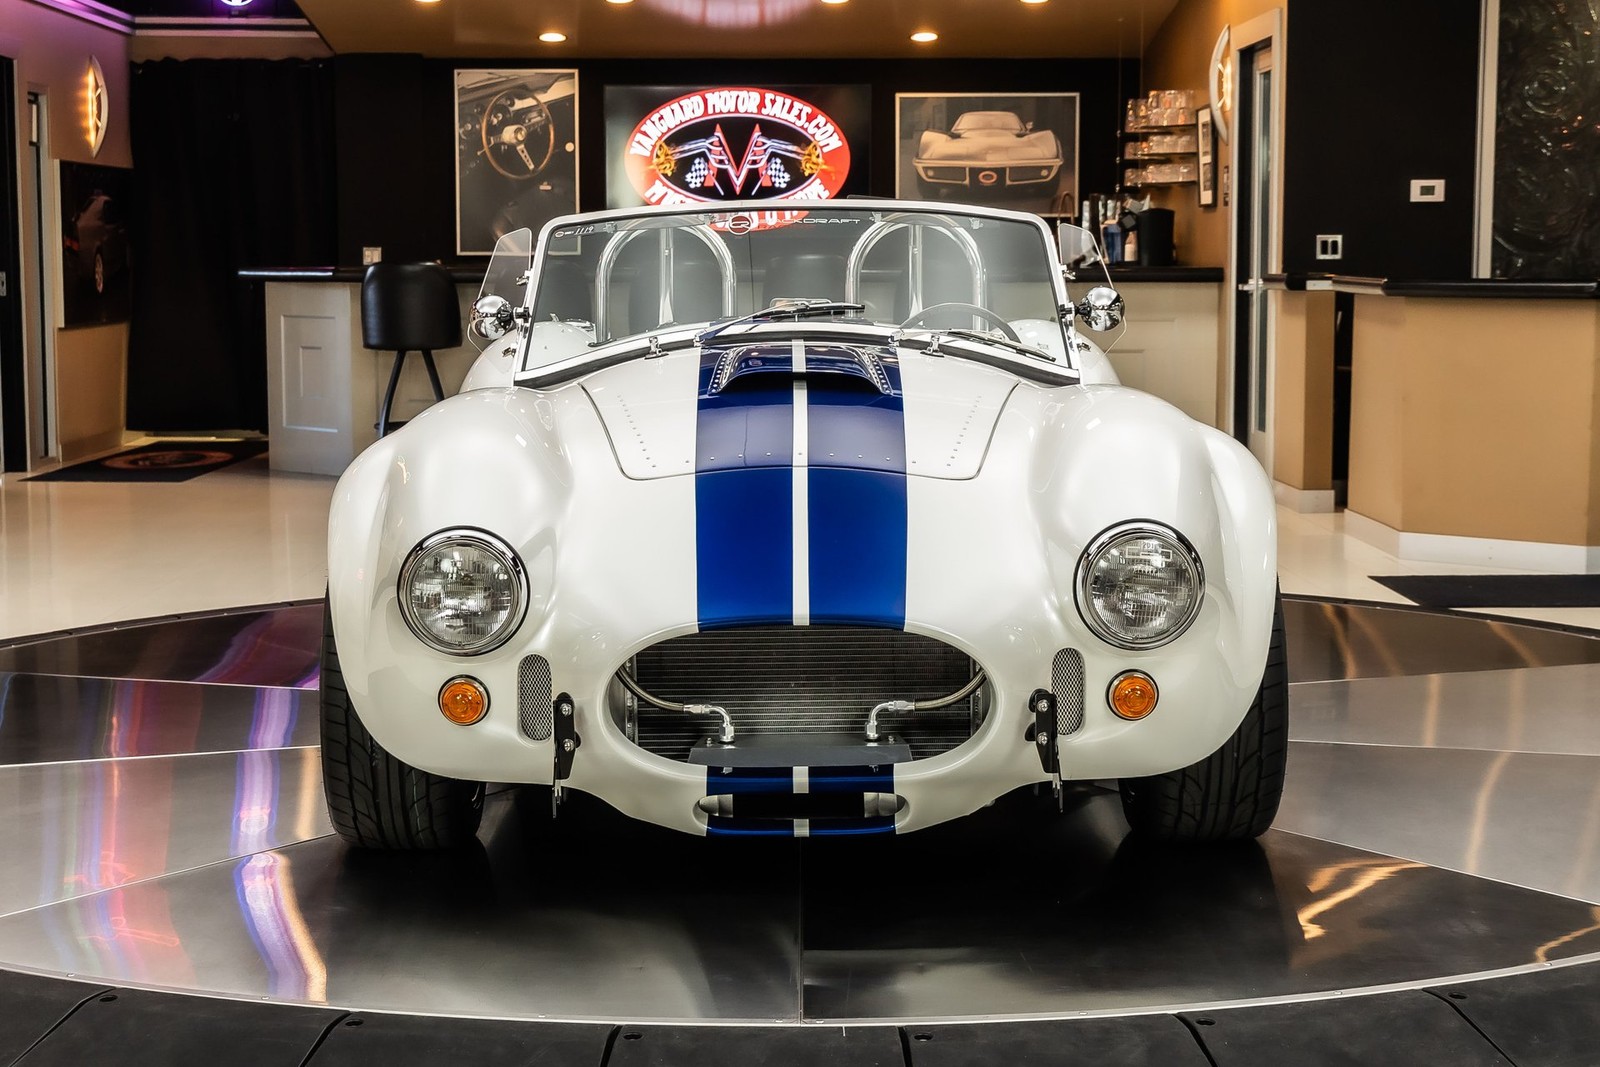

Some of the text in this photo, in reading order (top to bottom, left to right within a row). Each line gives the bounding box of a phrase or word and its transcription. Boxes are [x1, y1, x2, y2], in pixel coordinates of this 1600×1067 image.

[629, 90, 843, 157] VANGUARD MOTOR SALES.COM
[758, 217, 861, 225] ACKDRAFT
